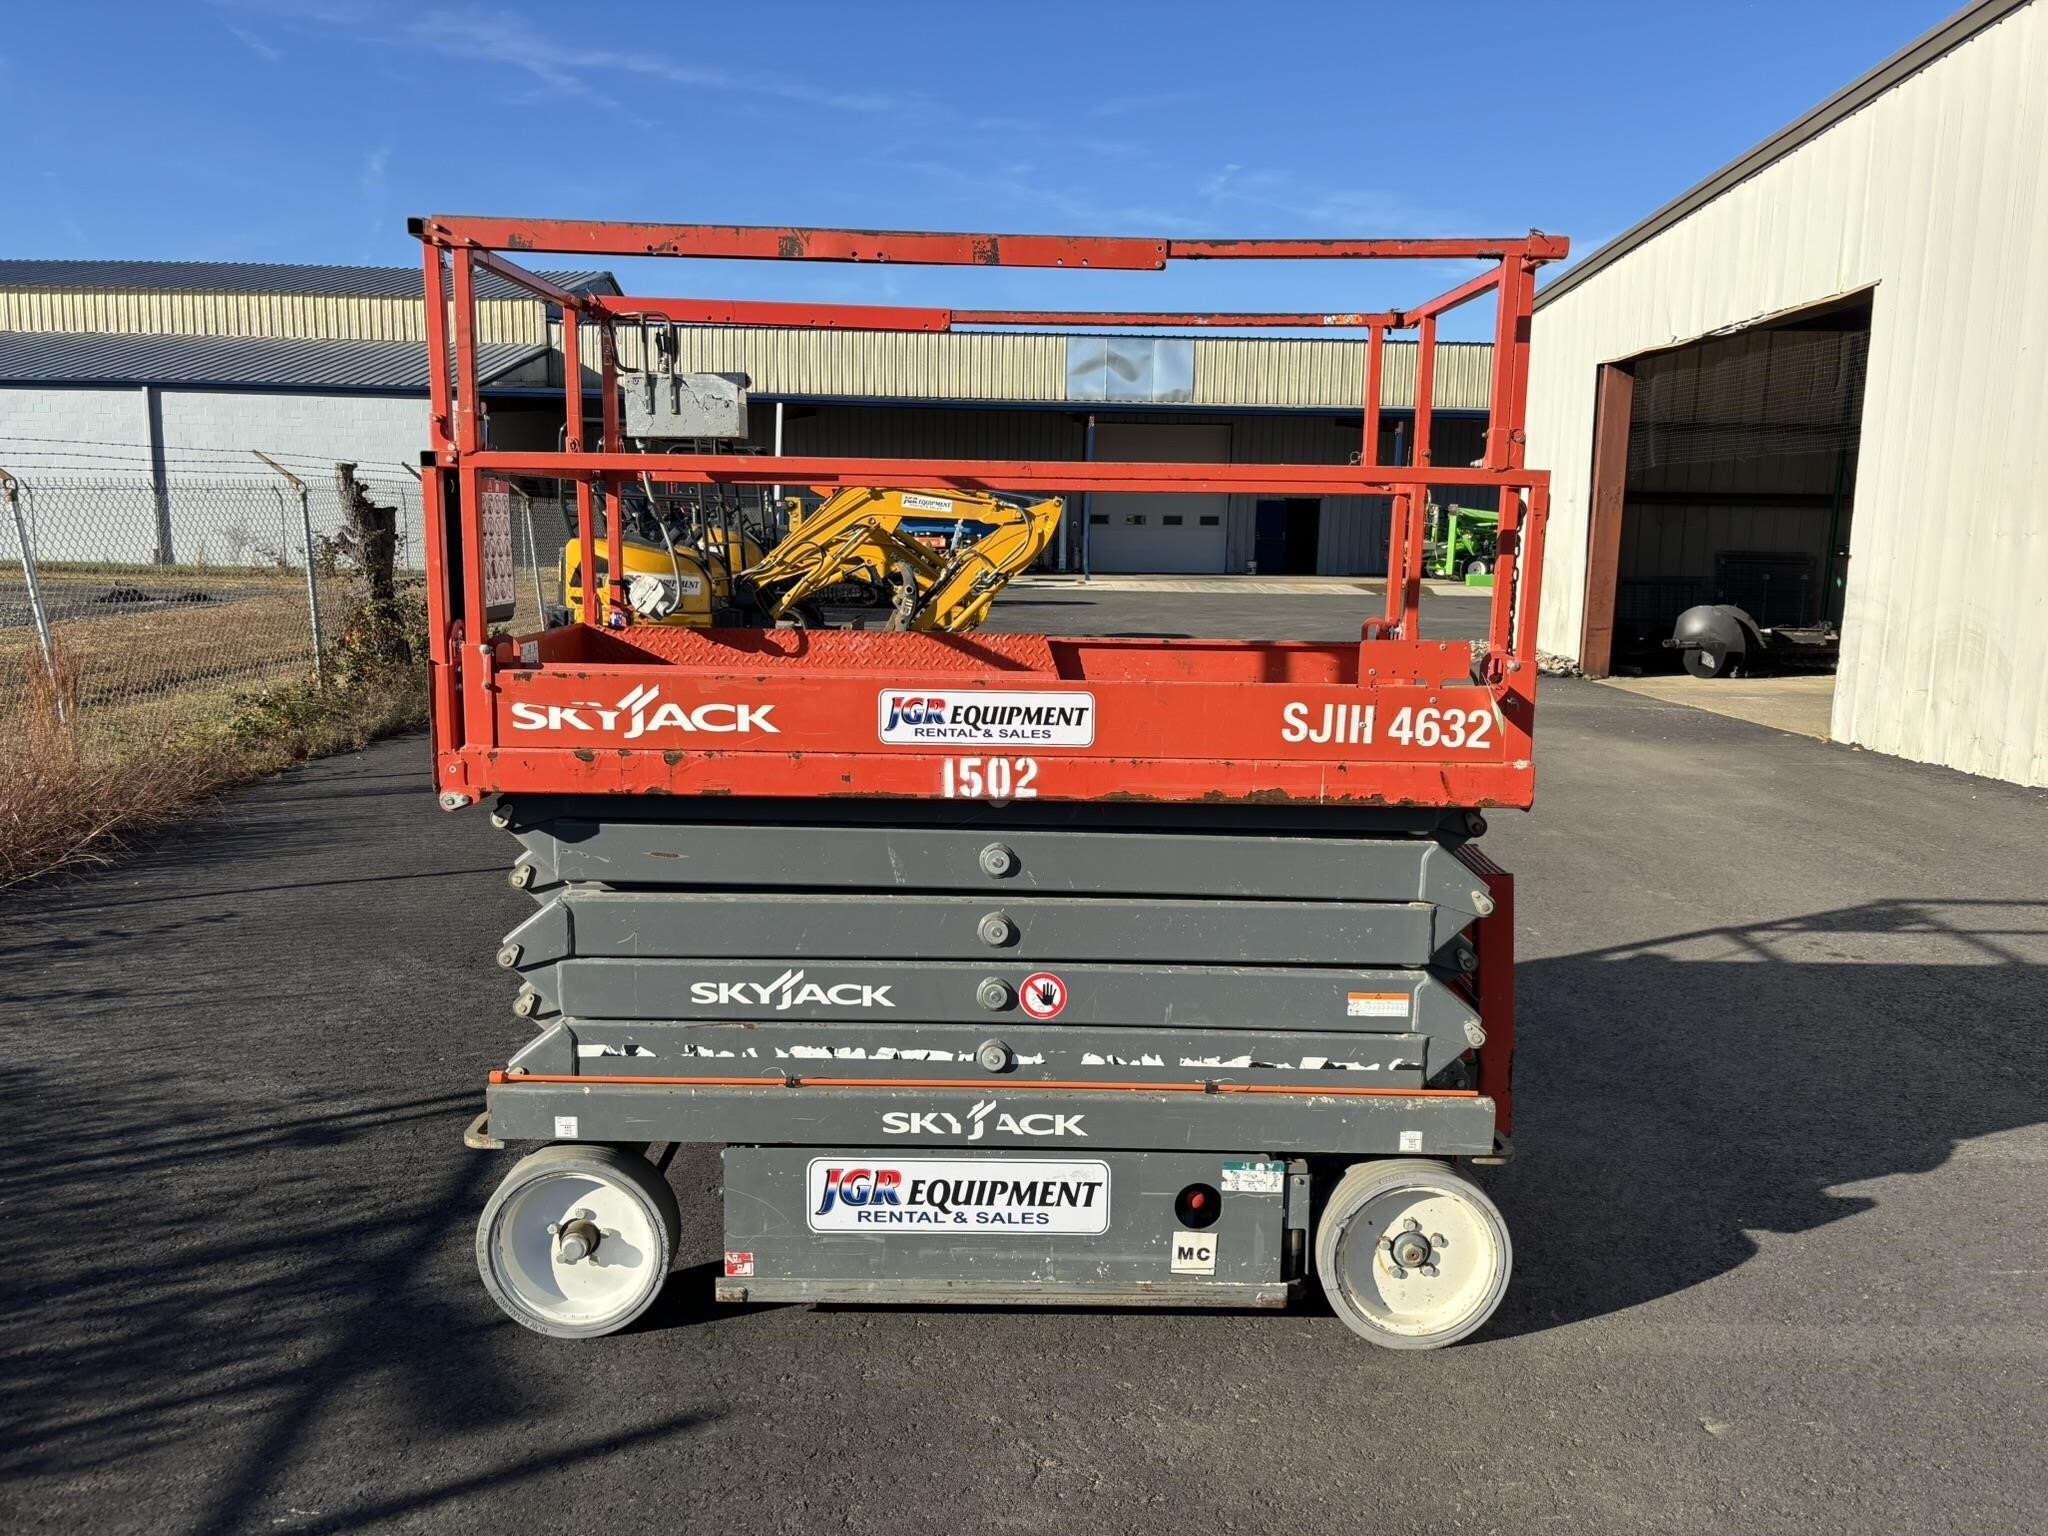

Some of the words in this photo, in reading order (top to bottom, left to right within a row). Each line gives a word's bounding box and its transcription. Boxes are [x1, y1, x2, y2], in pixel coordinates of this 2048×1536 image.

[511, 683, 781, 739] SKYJACK
[884, 697, 946, 731] JGR
[950, 705, 1089, 731] EQUIPMENT
[1388, 707, 1492, 748] 4632
[914, 727, 979, 738] RENTAL
[983, 729, 993, 738] &
[999, 729, 1051, 739] SALES
[943, 757, 1038, 798] 1502
[690, 969, 896, 1010] SKYJACK
[882, 1100, 1088, 1140] SKYJACK
[815, 1168, 902, 1215] JGR
[907, 1179, 1103, 1214] EQUIPMENT
[857, 1211, 946, 1223] RENTAL
[953, 1211, 968, 1224] &
[976, 1212, 1049, 1225] SALES
[1178, 1246, 1210, 1261] MC
